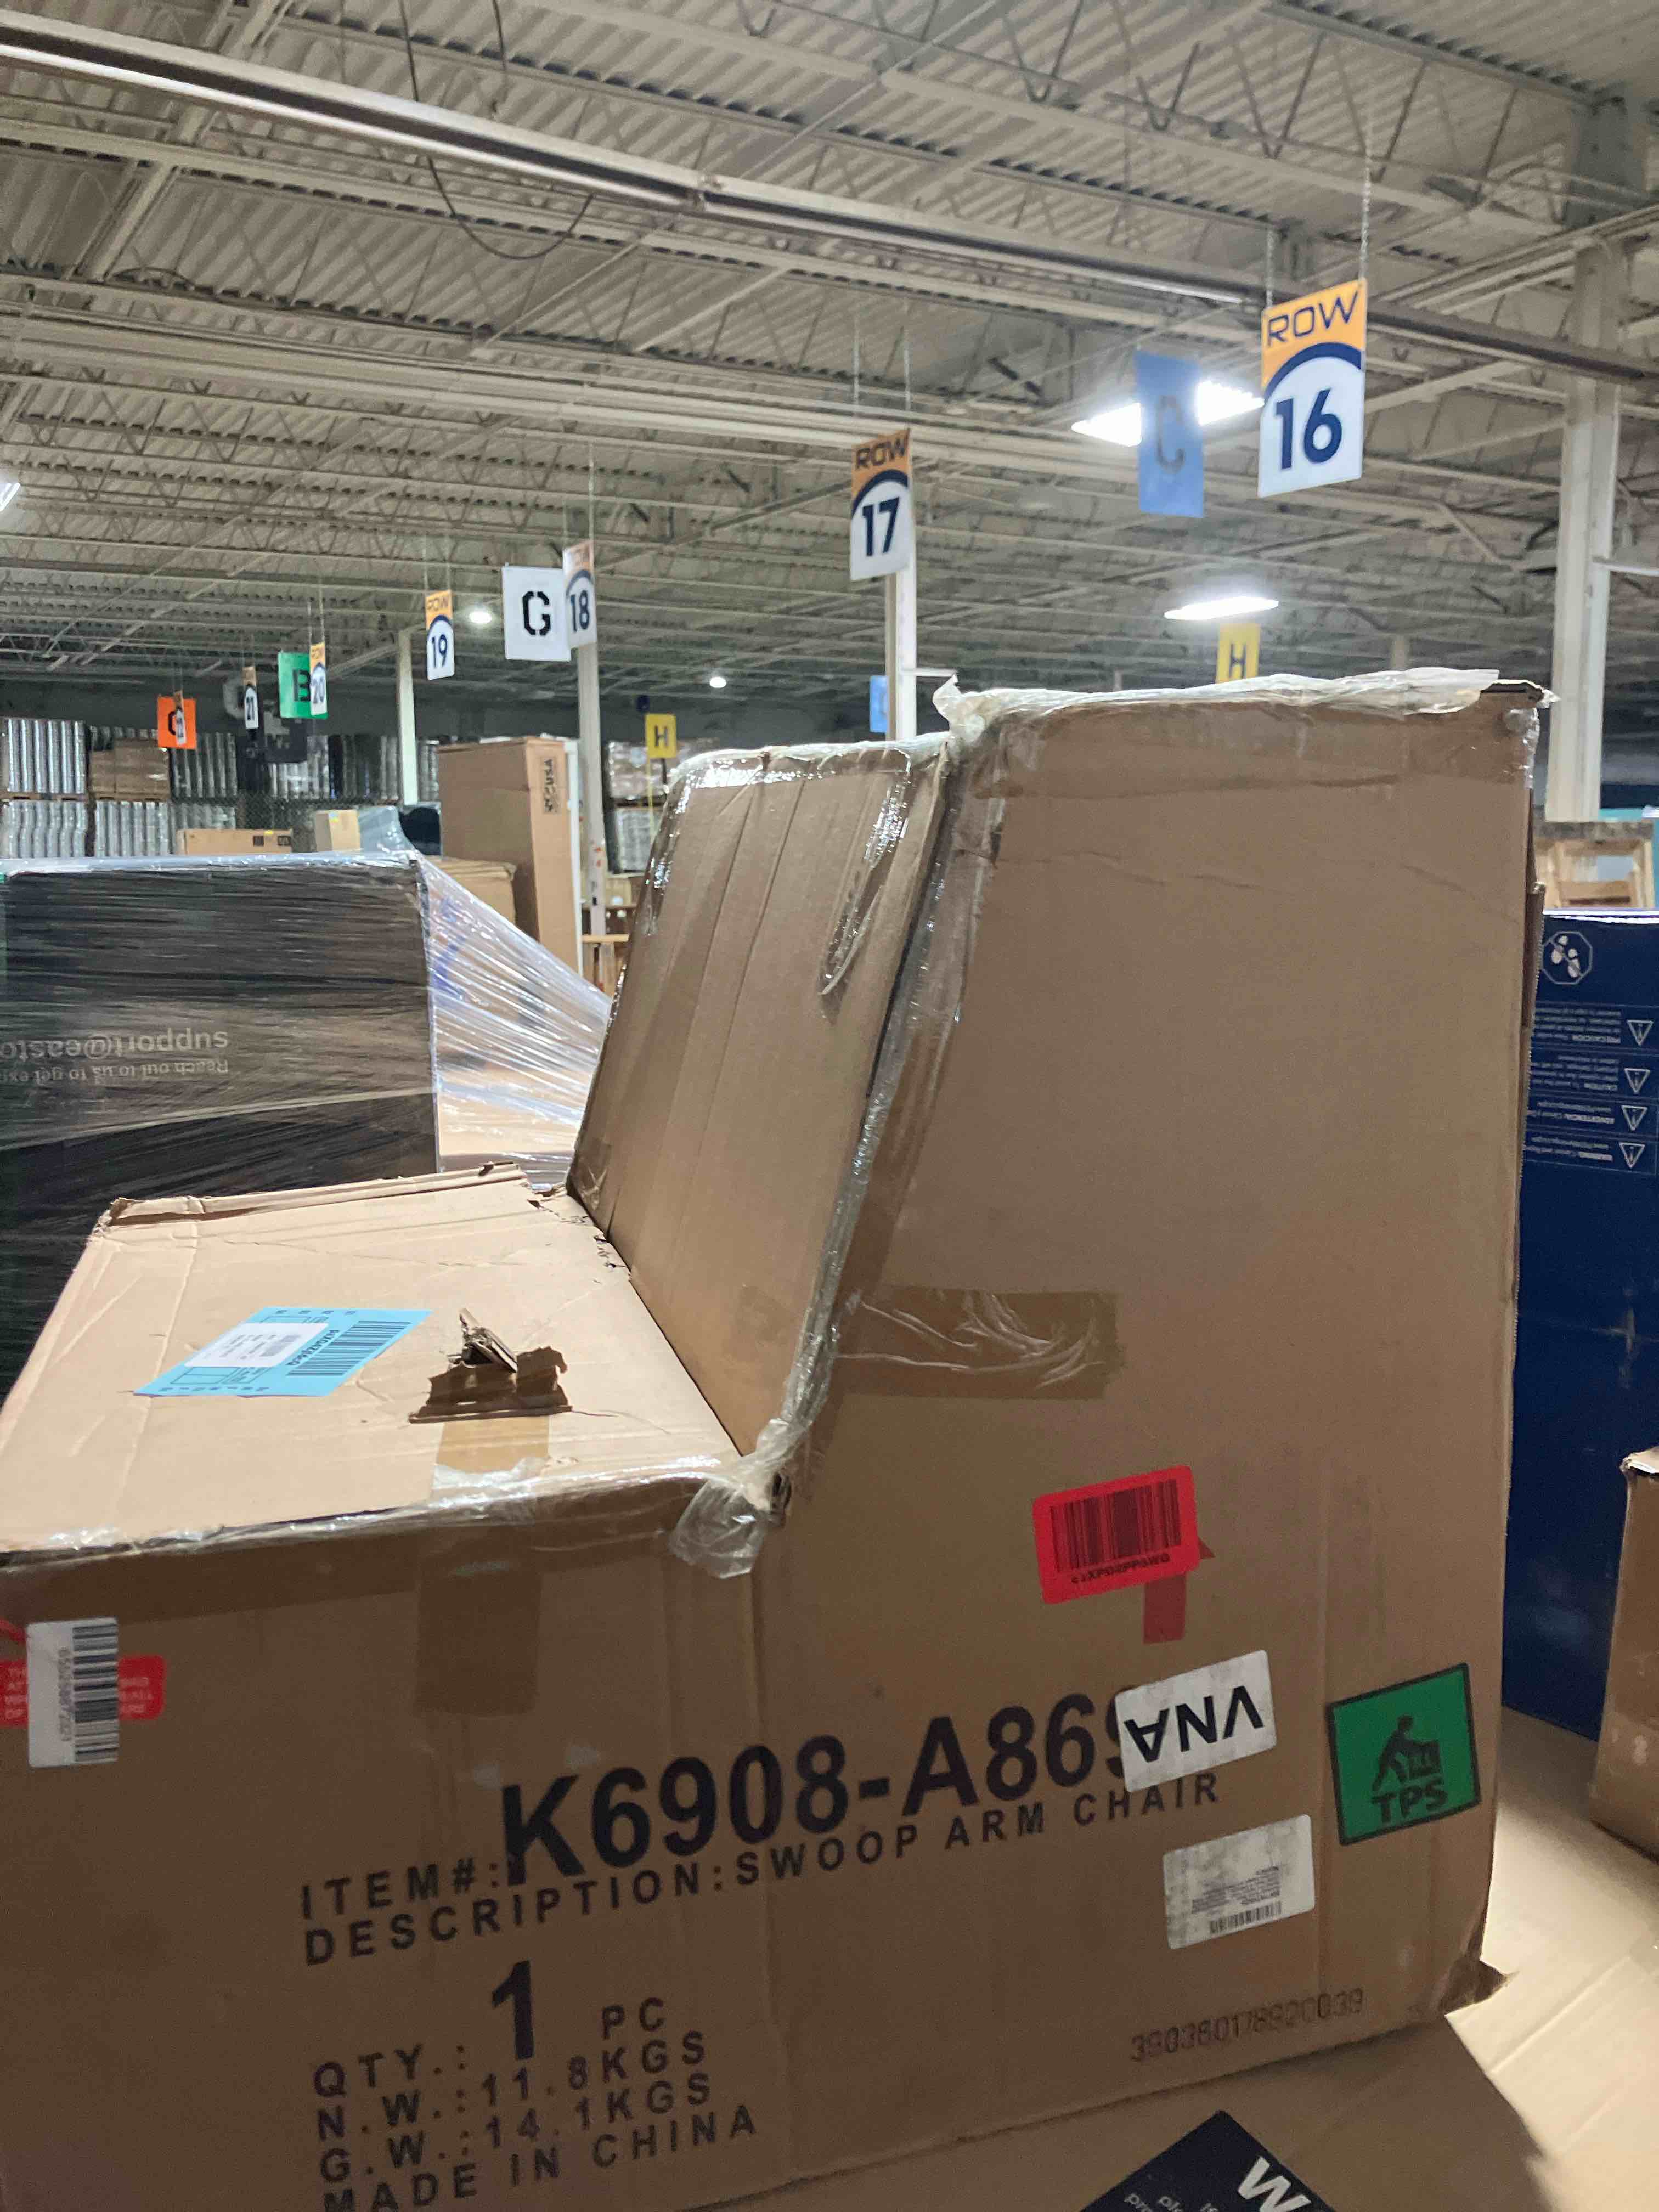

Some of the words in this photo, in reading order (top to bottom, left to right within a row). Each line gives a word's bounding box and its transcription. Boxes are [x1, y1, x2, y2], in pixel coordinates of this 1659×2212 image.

[1267, 290, 1358, 347] ROW
[1156, 394, 1186, 474] C
[1276, 387, 1343, 470] 16
[855, 436, 906, 470] ROW
[862, 496, 900, 557] 17
[522, 590, 551, 636] G
[570, 589, 590, 633] 18
[432, 634, 448, 669] 19
[1229, 643, 1247, 679] H
[292, 668, 311, 702] B
[653, 724, 668, 748] H
[944, 1802, 1045, 1852] ARM
[1073, 1773, 1219, 1828] CHAIR
[1372, 1778, 1448, 1824] TPS
[492, 1960, 534, 2061] 1
[602, 1997, 664, 2040] PC
[324, 2163, 477, 2212] MADE
[510, 2148, 560, 2187] IN
[593, 2106, 757, 2168] CHINA
